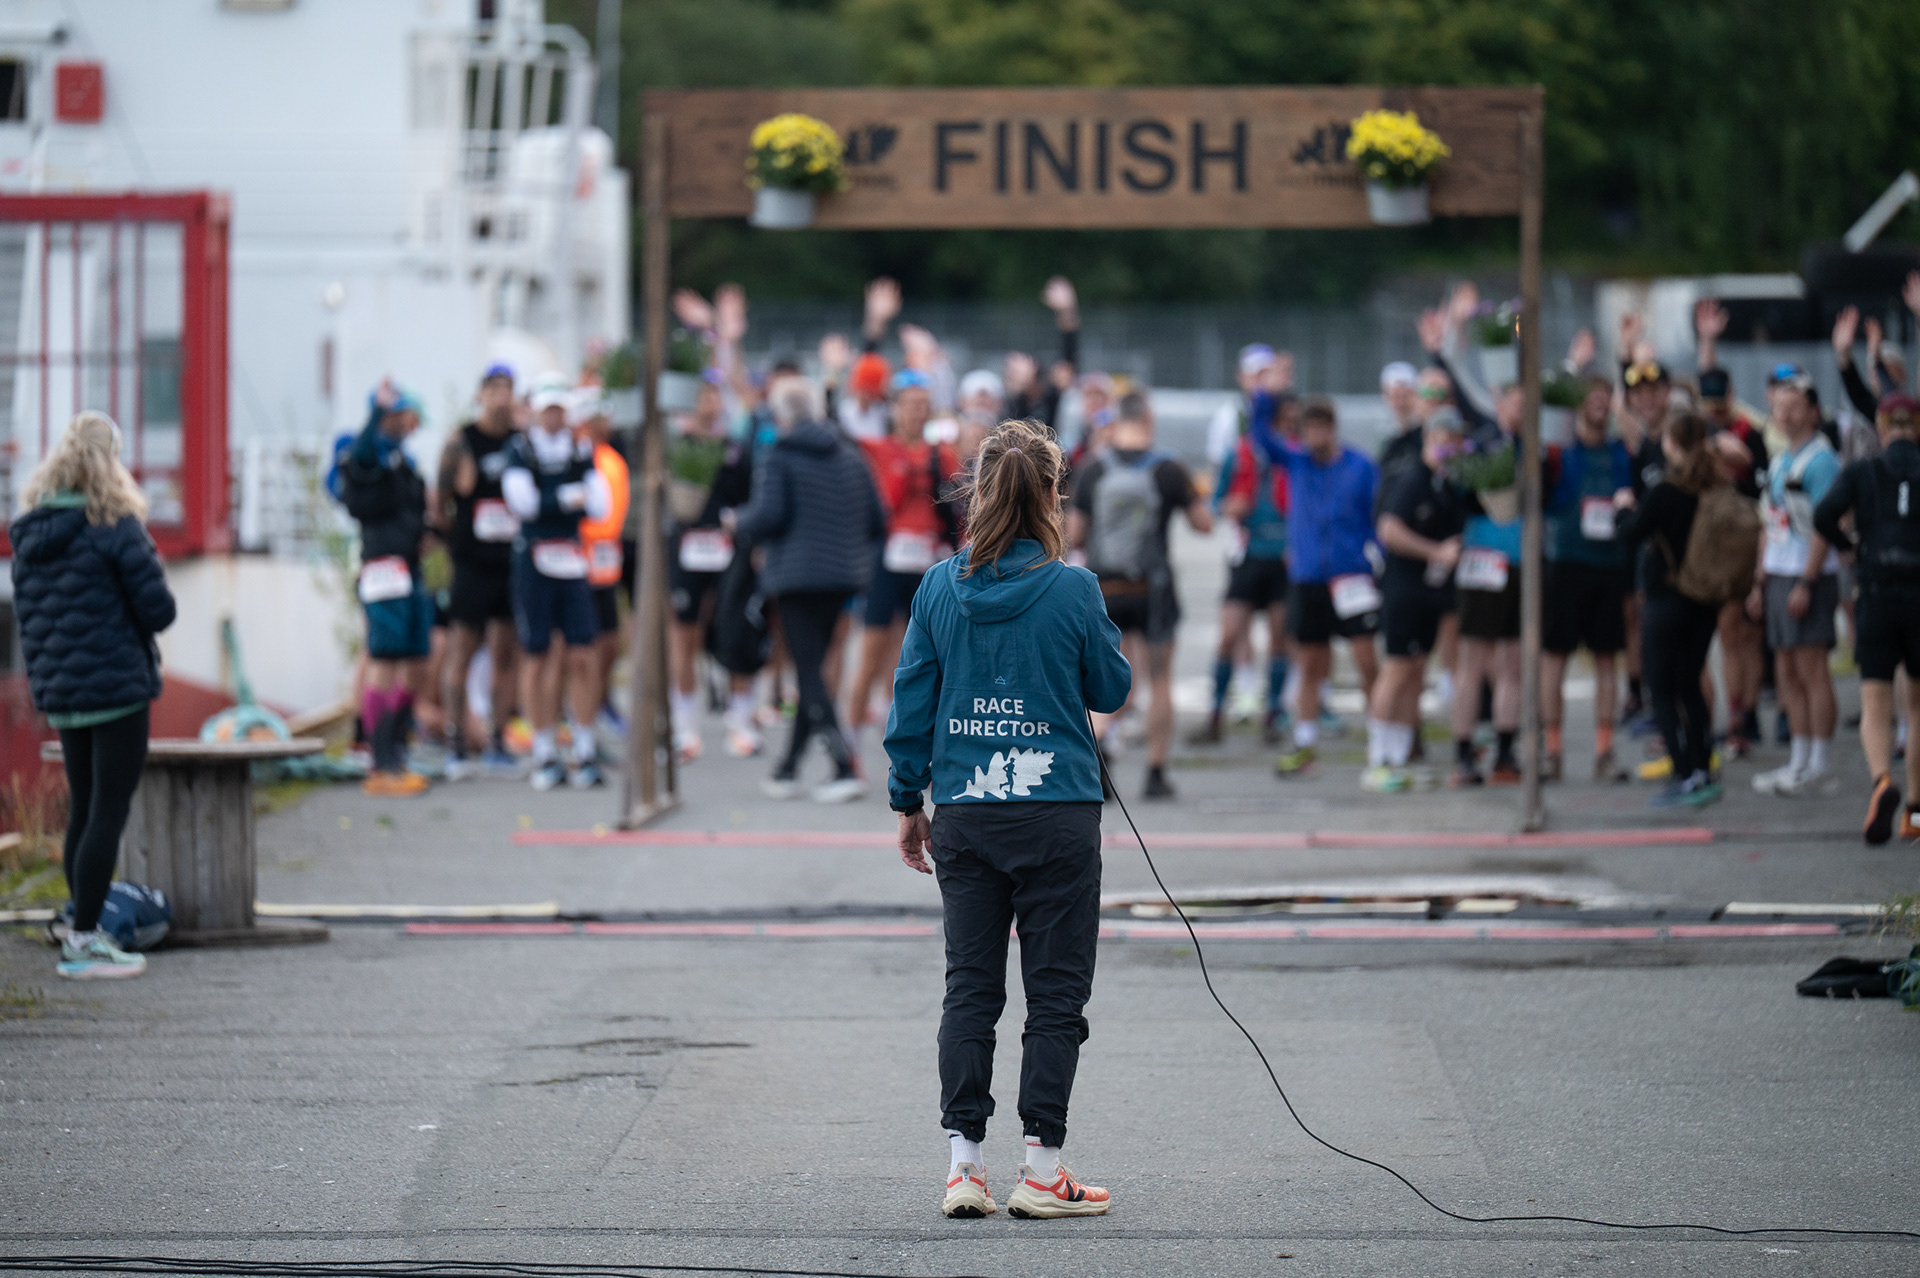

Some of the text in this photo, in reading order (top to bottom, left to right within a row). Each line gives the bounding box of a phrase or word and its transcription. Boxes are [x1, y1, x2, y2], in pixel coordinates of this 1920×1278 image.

[935, 119, 1248, 194] FINISH
[973, 697, 1024, 715] RACE
[949, 718, 1051, 737] DIRECTOR
